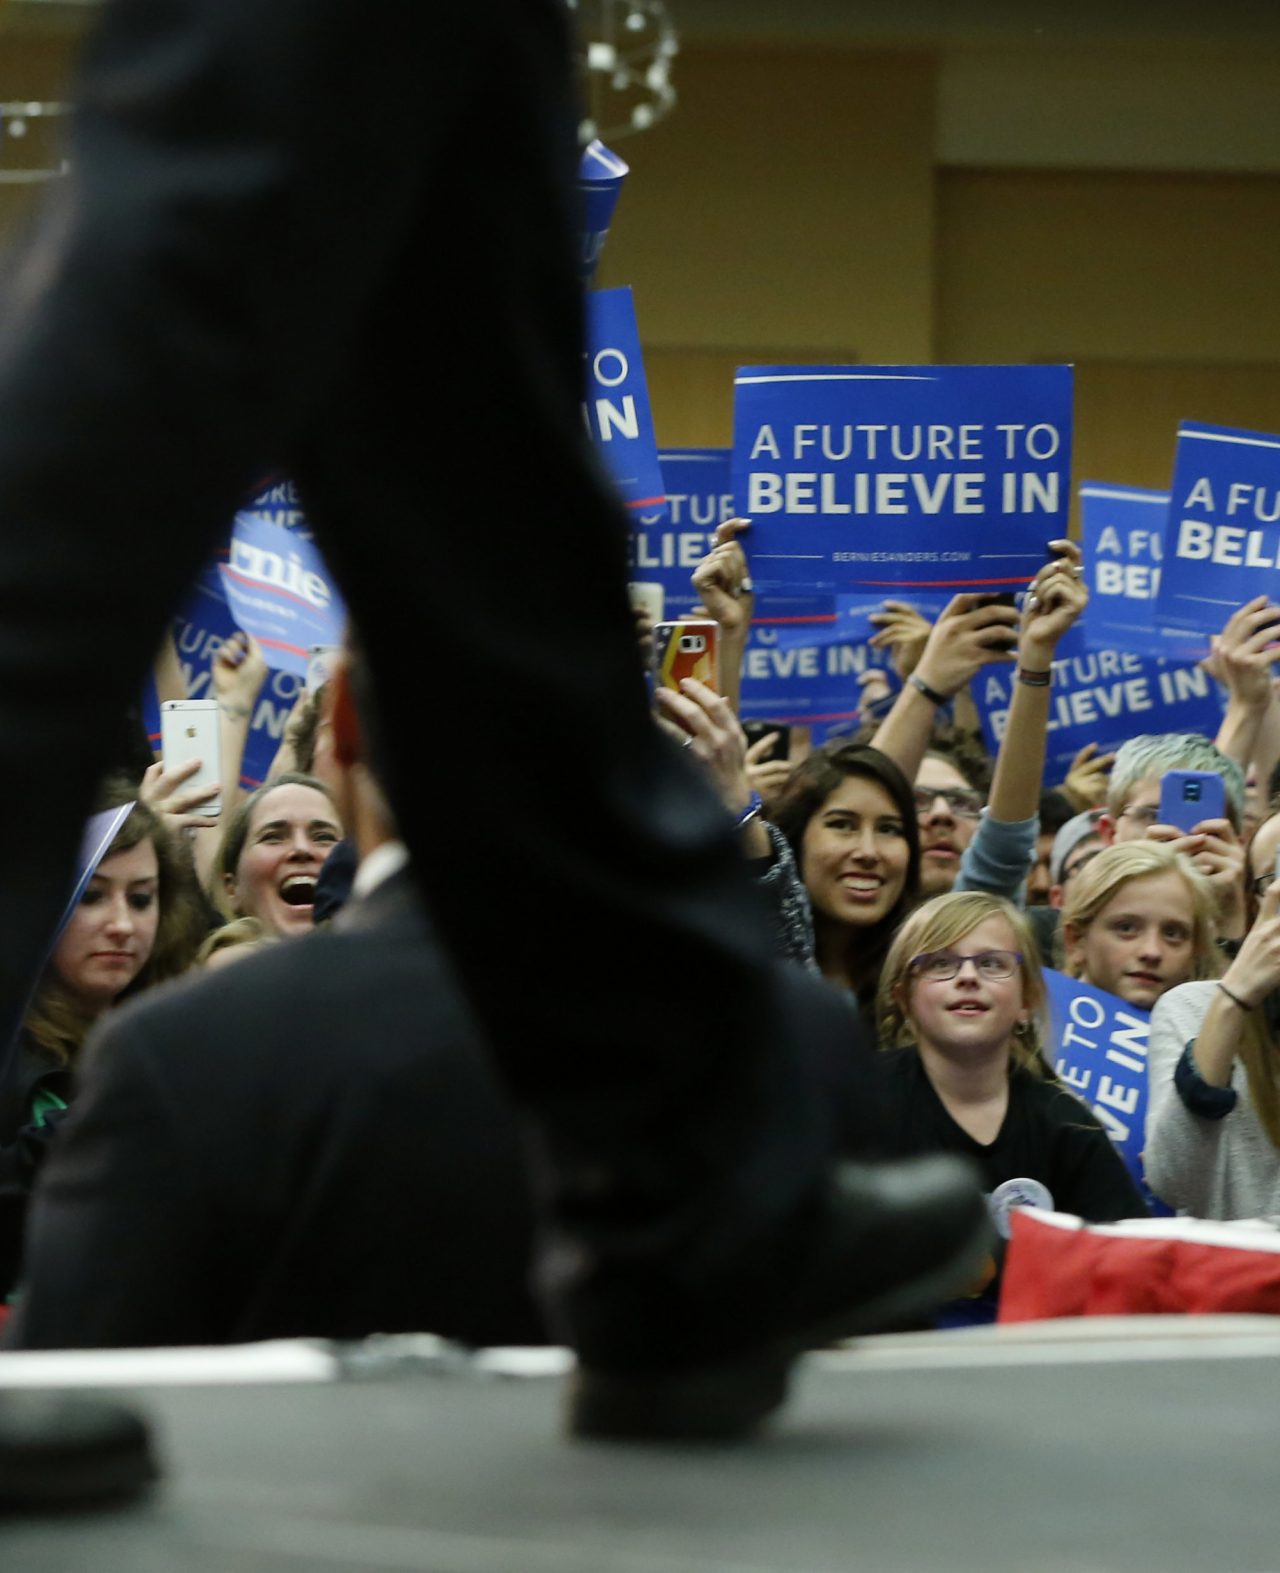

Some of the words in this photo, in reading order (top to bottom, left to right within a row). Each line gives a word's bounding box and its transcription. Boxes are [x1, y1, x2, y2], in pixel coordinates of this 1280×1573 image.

[583, 395, 639, 442] N
[749, 424, 781, 460] A
[793, 424, 985, 461] FUTURE
[996, 423, 1060, 461] TO
[747, 472, 986, 515] BELIEVE
[1002, 471, 1059, 514] IN
[1183, 477, 1216, 513] A
[1095, 525, 1123, 557] A
[1175, 518, 1280, 570] BEL
[827, 644, 868, 676] IN
[985, 677, 1007, 705] A
[1159, 665, 1209, 705] IN
[1062, 996, 1105, 1049] TO
[1105, 1011, 1151, 1073] IN
